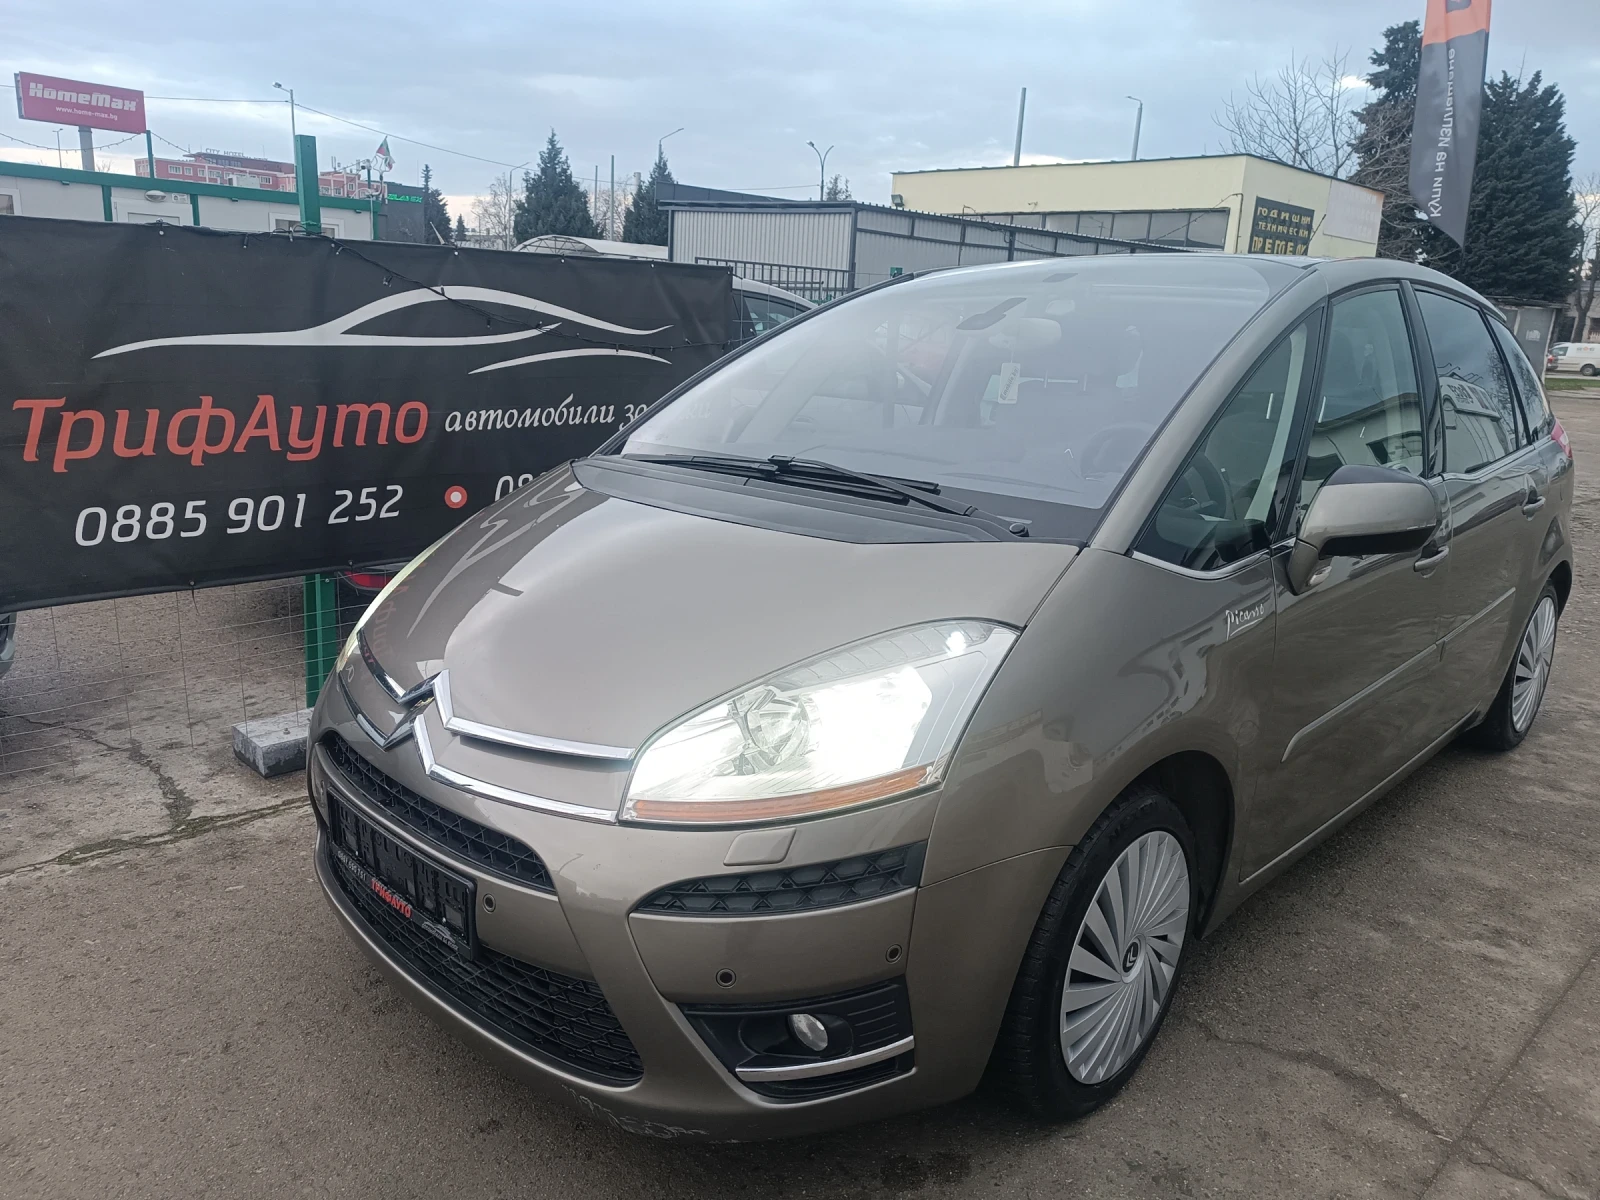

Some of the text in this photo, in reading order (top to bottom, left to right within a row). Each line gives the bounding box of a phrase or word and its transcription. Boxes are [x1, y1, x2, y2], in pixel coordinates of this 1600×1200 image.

[29, 82, 137, 111] HomeMax
[55, 105, 118, 121] www.home-max.bg
[223, 150, 245, 158] HOTEL
[1257, 206, 1310, 224] ГОДИШНИ
[1258, 221, 1308, 238] ТЕХНИЧЕСКИ
[12, 394, 429, 473] ТрифАуто
[444, 393, 615, 432] автомобили
[75, 485, 404, 547] 0885 901 252
